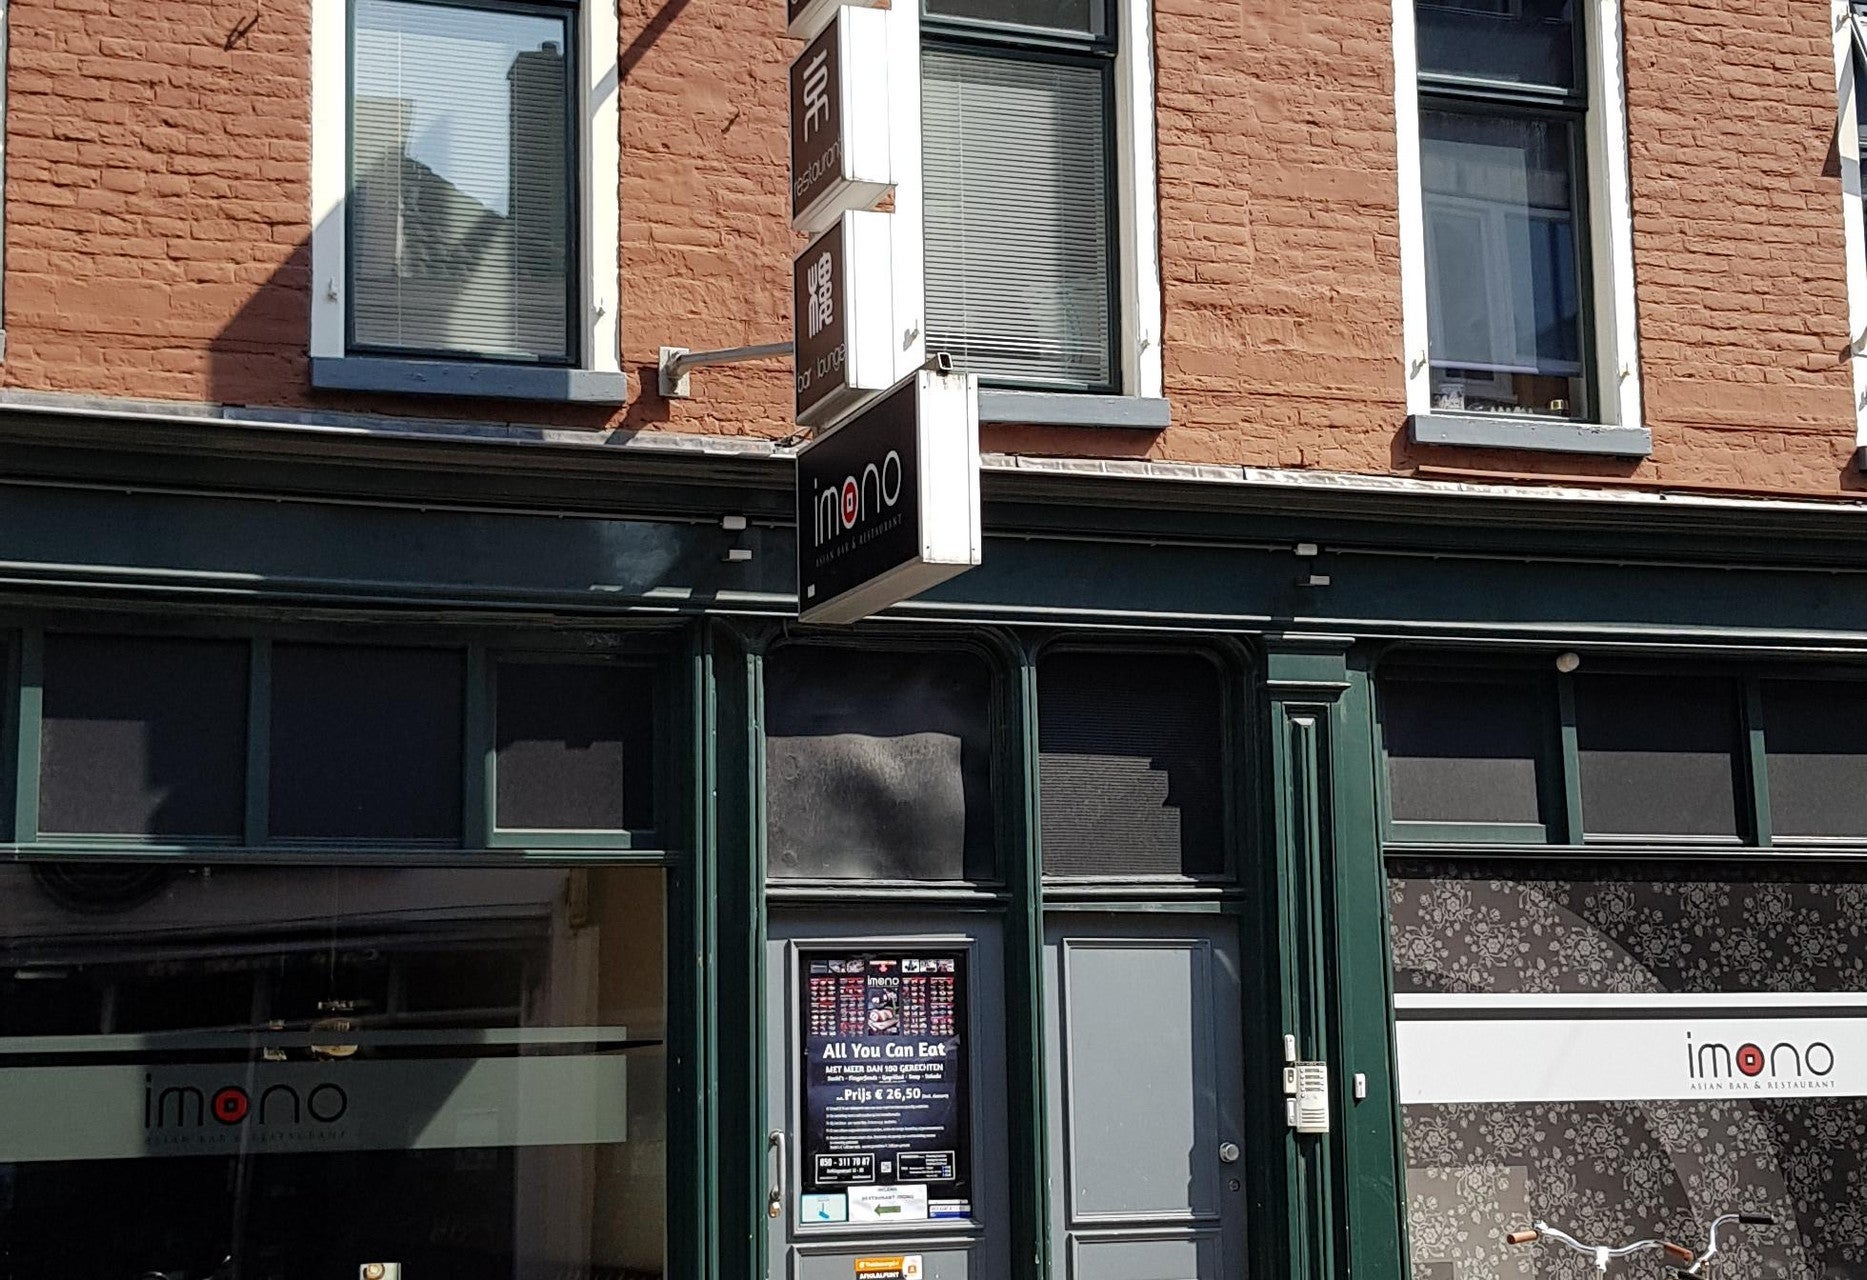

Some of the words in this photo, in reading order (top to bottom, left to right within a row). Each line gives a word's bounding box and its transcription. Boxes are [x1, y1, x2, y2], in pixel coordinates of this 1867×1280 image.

[794, 136, 842, 201] restaurant
[816, 343, 846, 380] lounge
[814, 450, 902, 548] imono
[815, 550, 835, 568] ASIAN
[859, 512, 903, 545] RESTAURANT
[822, 1042, 848, 1059] All
[851, 1042, 881, 1059] You
[885, 1041, 914, 1058] Can
[918, 1041, 947, 1057] Eat
[866, 1064, 883, 1073] DAN
[1686, 1031, 1835, 1078] imono
[144, 1072, 348, 1129] imono
[844, 1087, 872, 1103] Prijs
[886, 1087, 921, 1102] 26,50
[1690, 1082, 1723, 1090] ASIAN
[1729, 1081, 1750, 1090] BAR
[1754, 1081, 1761, 1090] &
[1767, 1080, 1836, 1089] RESTAURANT
